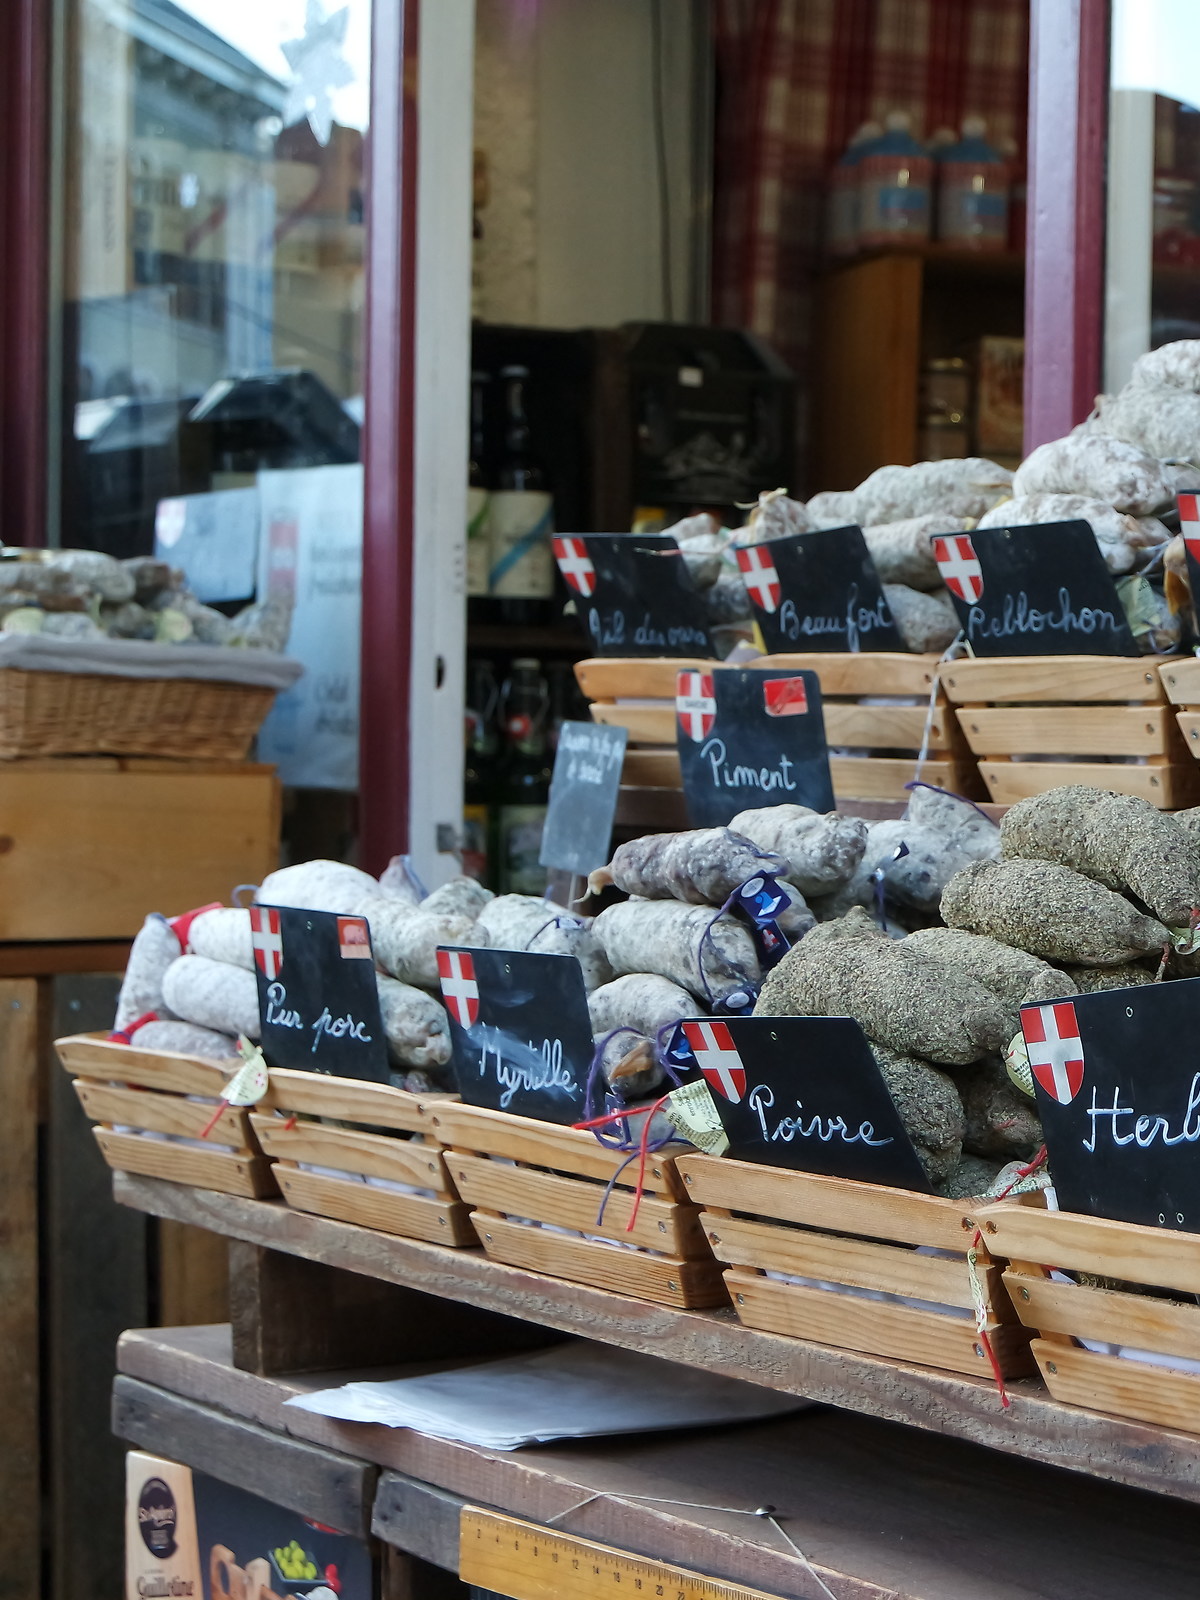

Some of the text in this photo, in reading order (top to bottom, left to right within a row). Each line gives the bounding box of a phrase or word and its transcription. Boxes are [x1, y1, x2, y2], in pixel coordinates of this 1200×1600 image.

[779, 583, 896, 653] Beaufort
[968, 587, 1124, 640] Reblochon
[700, 738, 798, 792] Piment
[265, 982, 373, 1053] Pur porc
[748, 1083, 894, 1147] Poivre
[655, 1584, 664, 1597] 20
